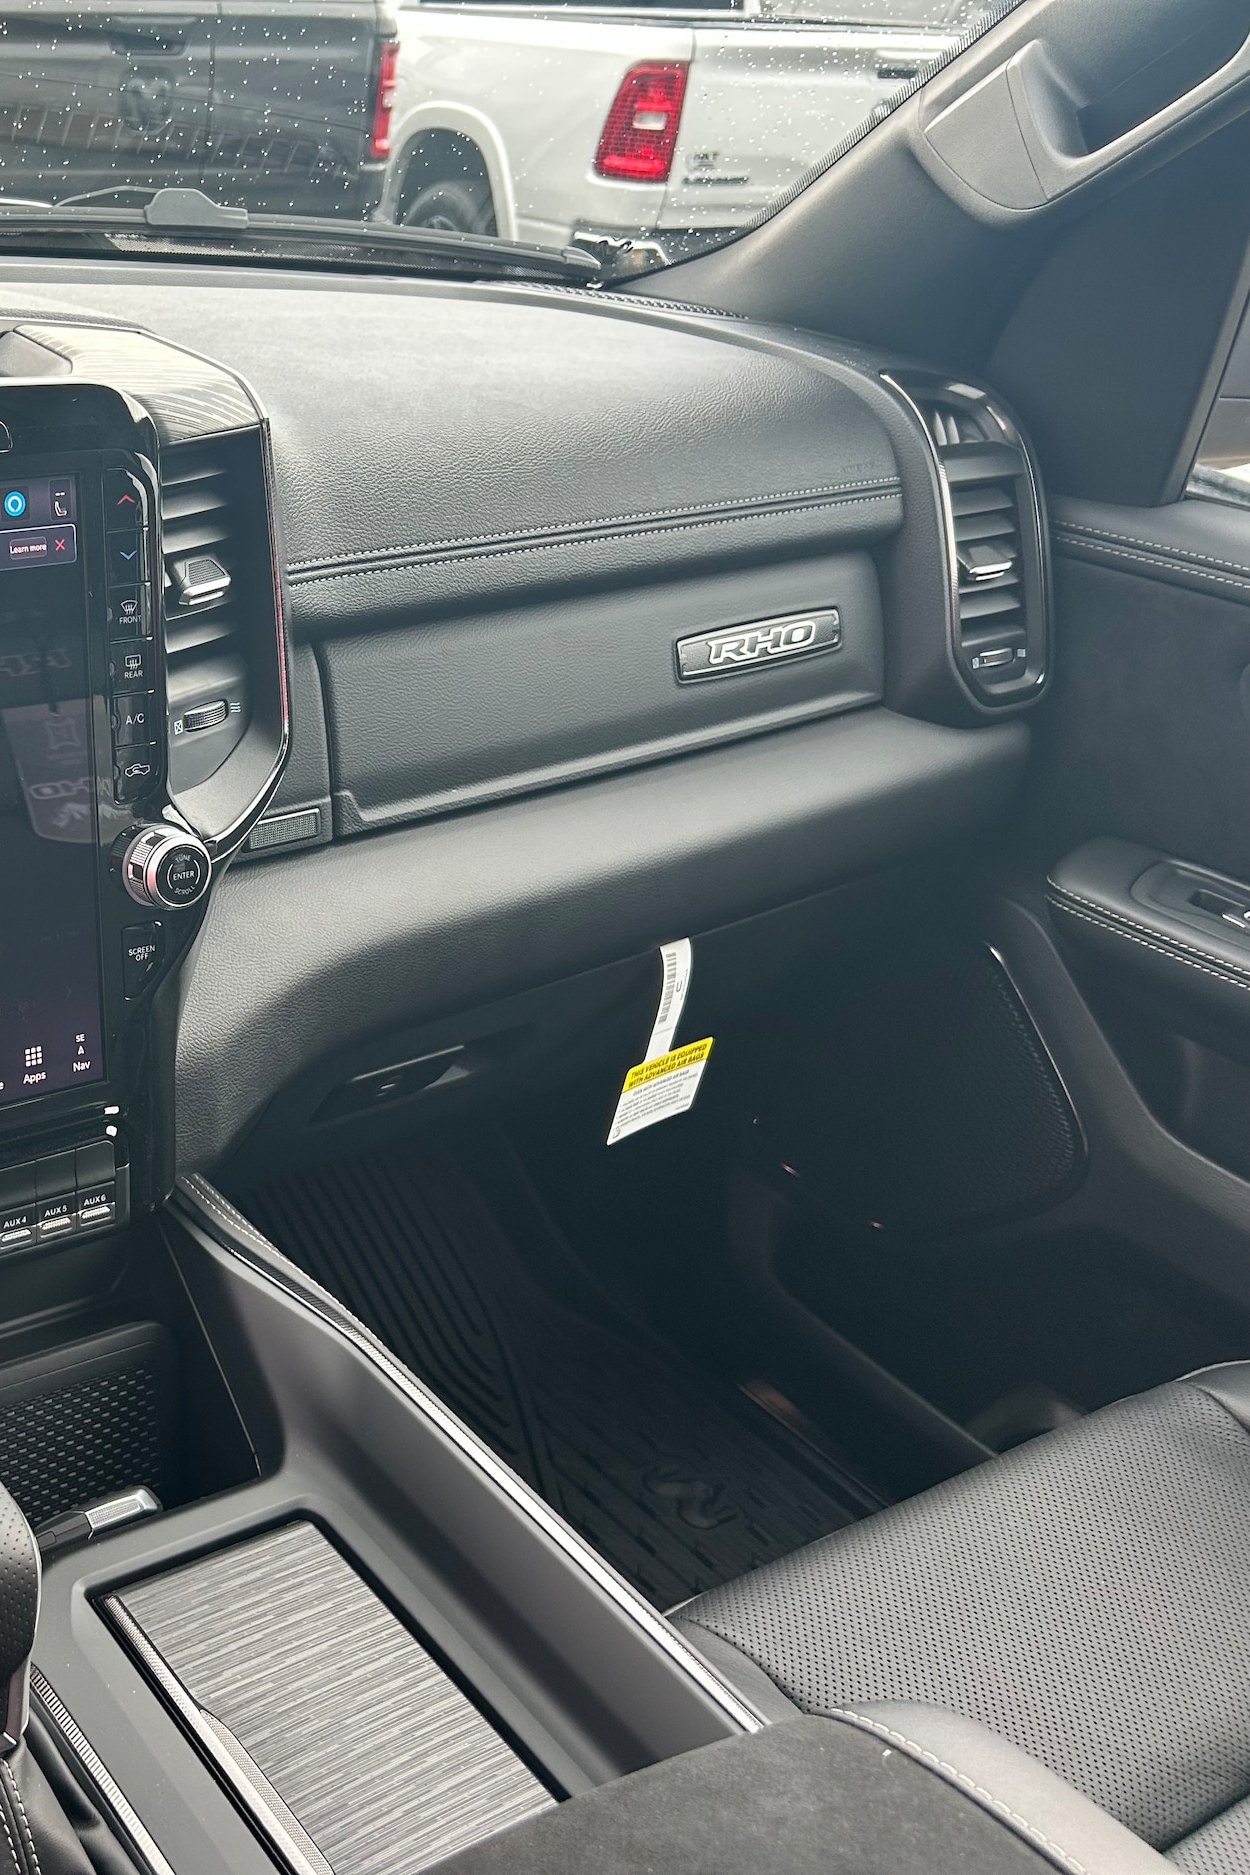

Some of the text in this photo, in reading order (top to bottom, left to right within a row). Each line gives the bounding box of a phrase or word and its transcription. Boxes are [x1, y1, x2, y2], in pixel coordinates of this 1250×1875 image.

[9, 543, 47, 554] Learn more
[119, 615, 142, 624] FRONT
[706, 621, 816, 664] RHO
[124, 671, 144, 679] REAR
[125, 713, 145, 725] A/C
[175, 854, 191, 863] TUNE
[173, 870, 195, 881] ENTER
[174, 886, 196, 896] SCROLL
[128, 945, 156, 956] SCREEN
[136, 953, 149, 961] OFF
[75, 1033, 86, 1043] SE
[73, 1059, 91, 1073] Nav
[23, 1070, 47, 1086] Apps
[84, 1196, 100, 1206] AUX
[45, 1205, 68, 1217] AUX 5
[3, 1218, 20, 1229] AUX
